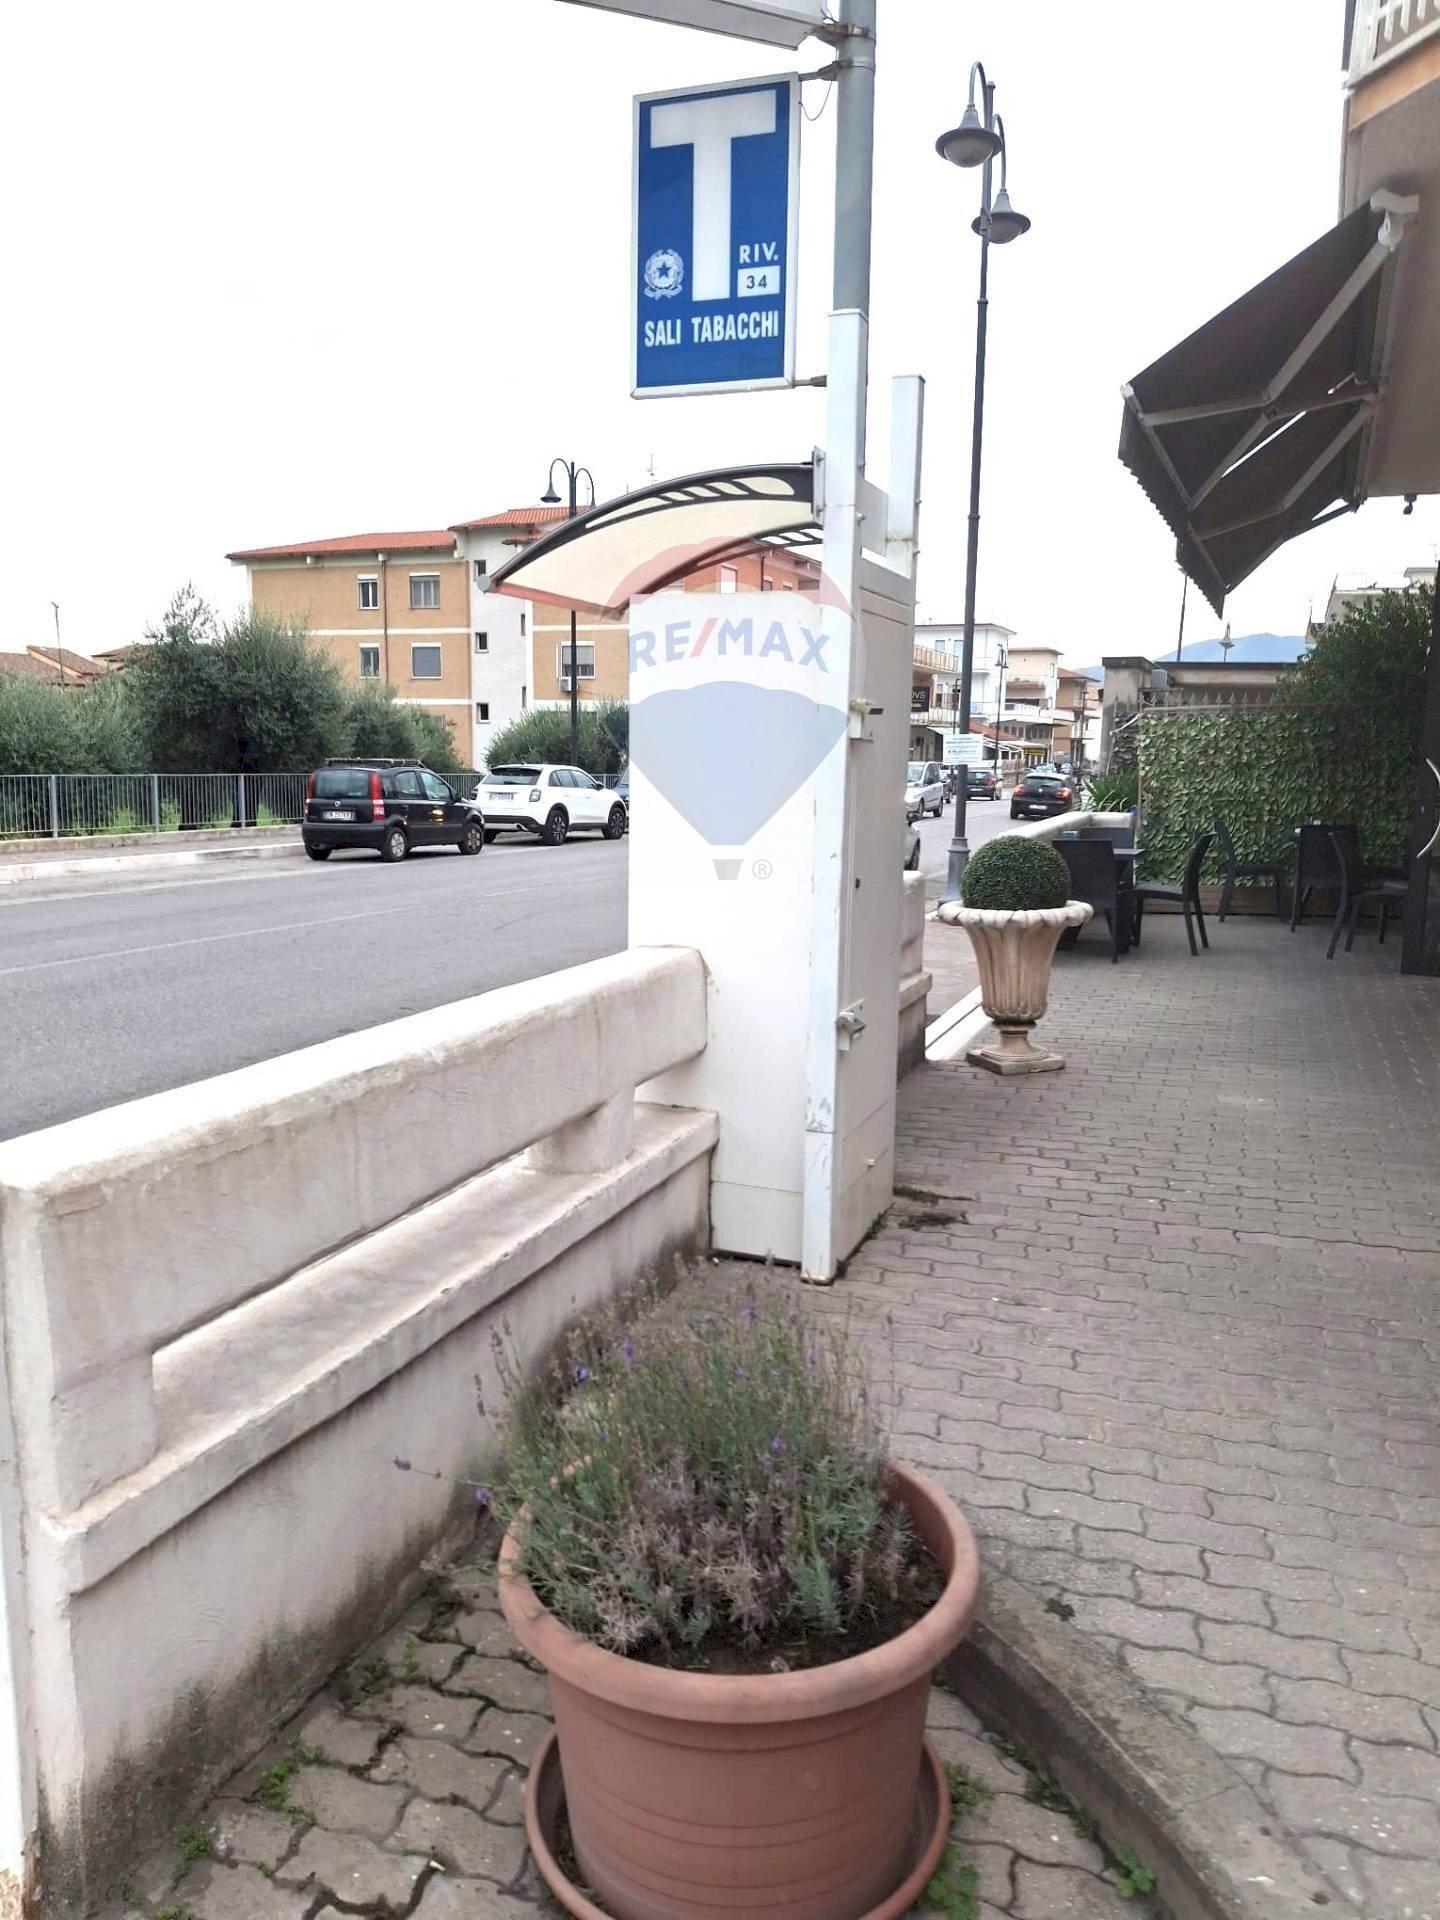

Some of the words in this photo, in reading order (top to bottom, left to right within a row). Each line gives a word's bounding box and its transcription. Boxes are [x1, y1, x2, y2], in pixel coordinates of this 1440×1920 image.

[651, 89, 777, 301] T
[739, 242, 779, 264] RIV.
[746, 275, 768, 289] 34
[645, 318, 681, 347] SALI
[692, 311, 779, 343] TABACCHI
